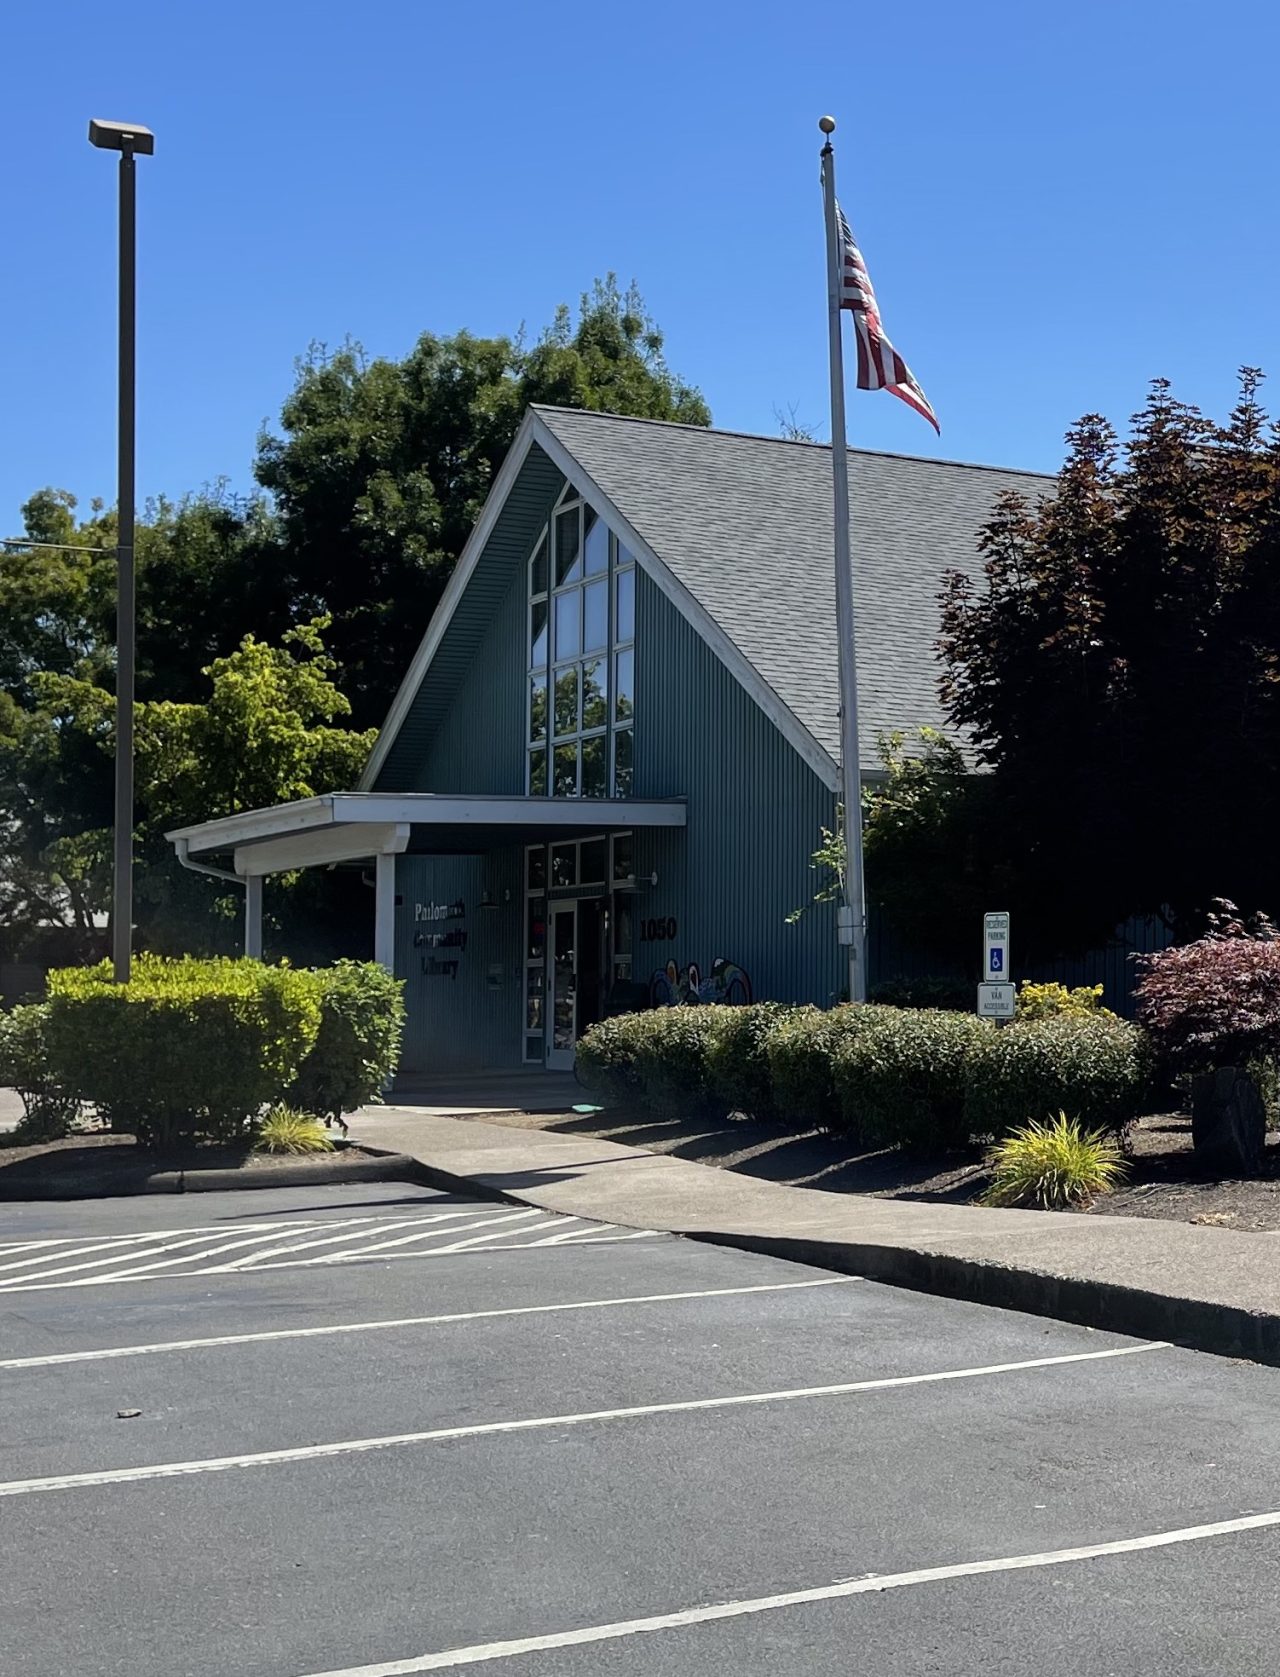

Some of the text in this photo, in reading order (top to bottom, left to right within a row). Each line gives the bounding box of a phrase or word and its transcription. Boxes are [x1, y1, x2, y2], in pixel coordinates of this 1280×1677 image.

[640, 917, 677, 941] 1050
[987, 932, 1005, 940] PARKING
[991, 992, 1002, 1000] VAN
